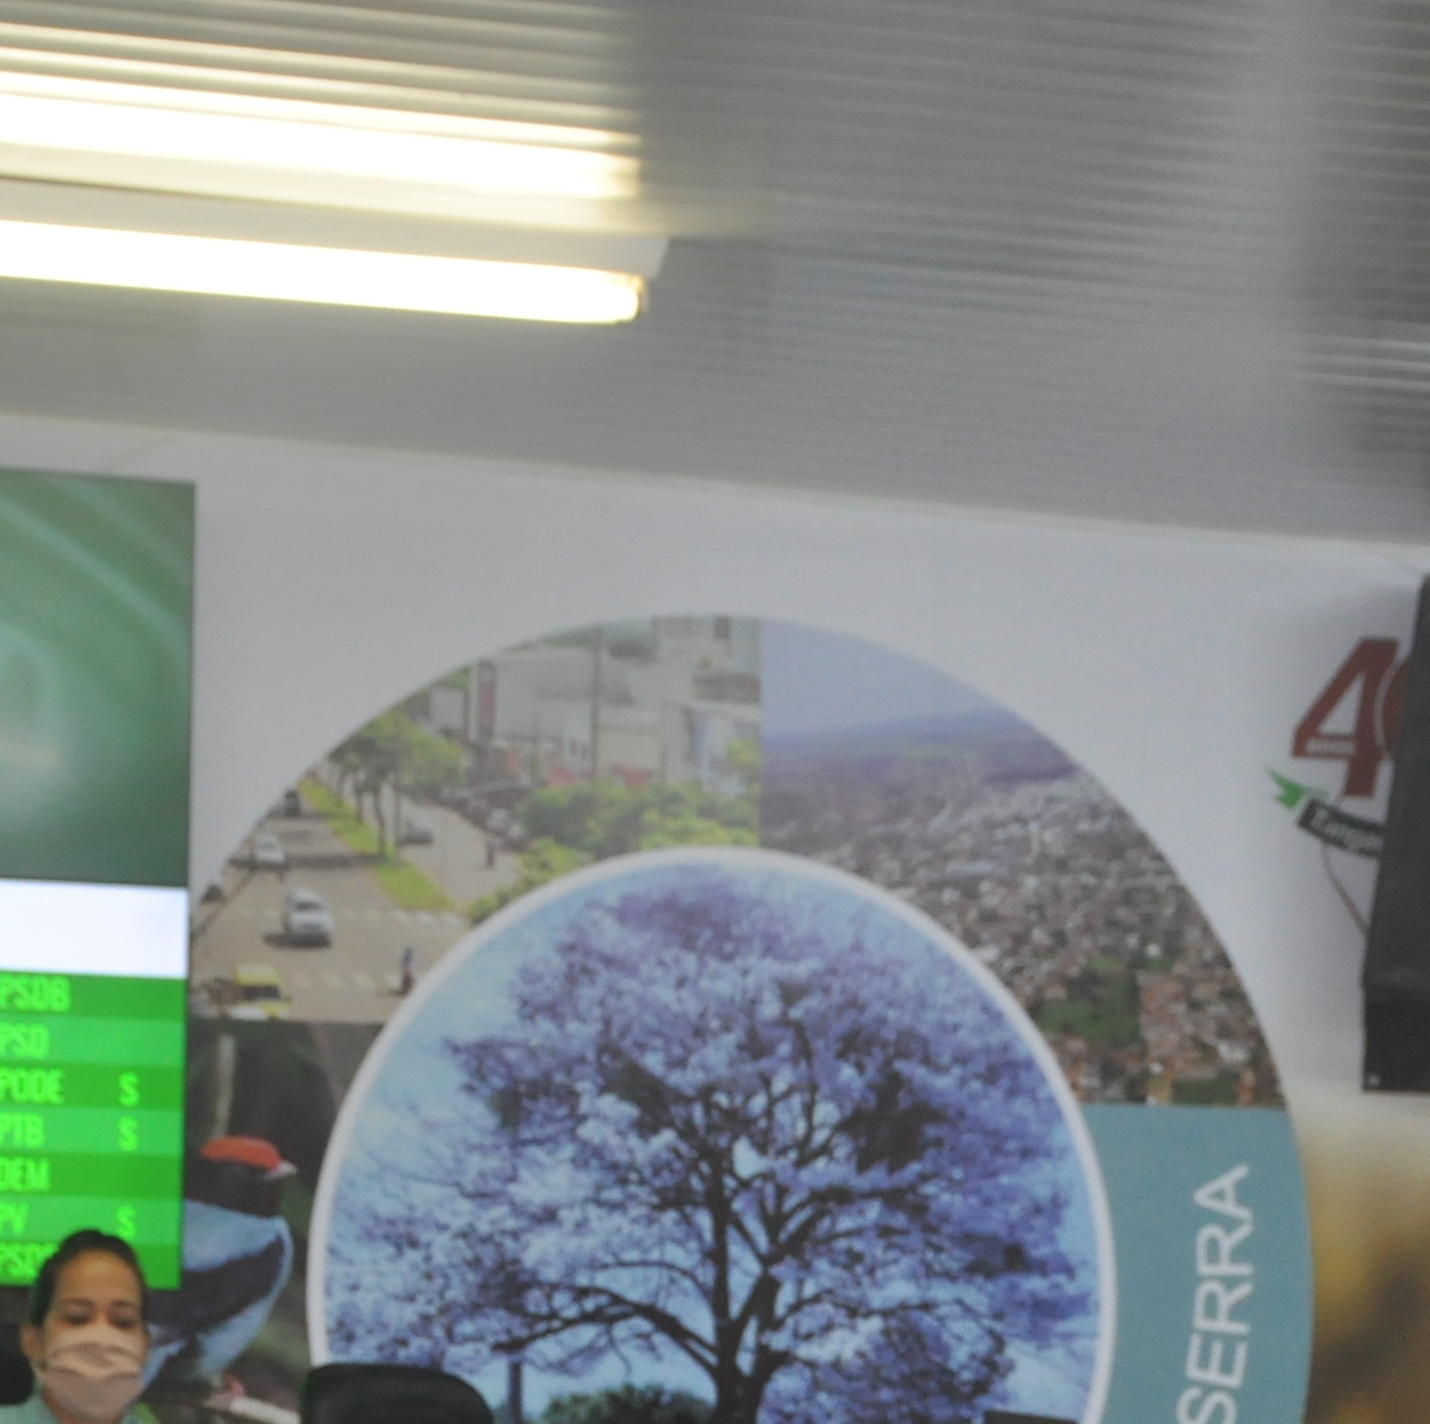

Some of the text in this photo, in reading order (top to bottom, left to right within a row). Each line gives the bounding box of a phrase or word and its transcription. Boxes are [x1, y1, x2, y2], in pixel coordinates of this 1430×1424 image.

[119, 1071, 140, 1107] S
[118, 1117, 139, 1152] S
[117, 1205, 137, 1240] S
